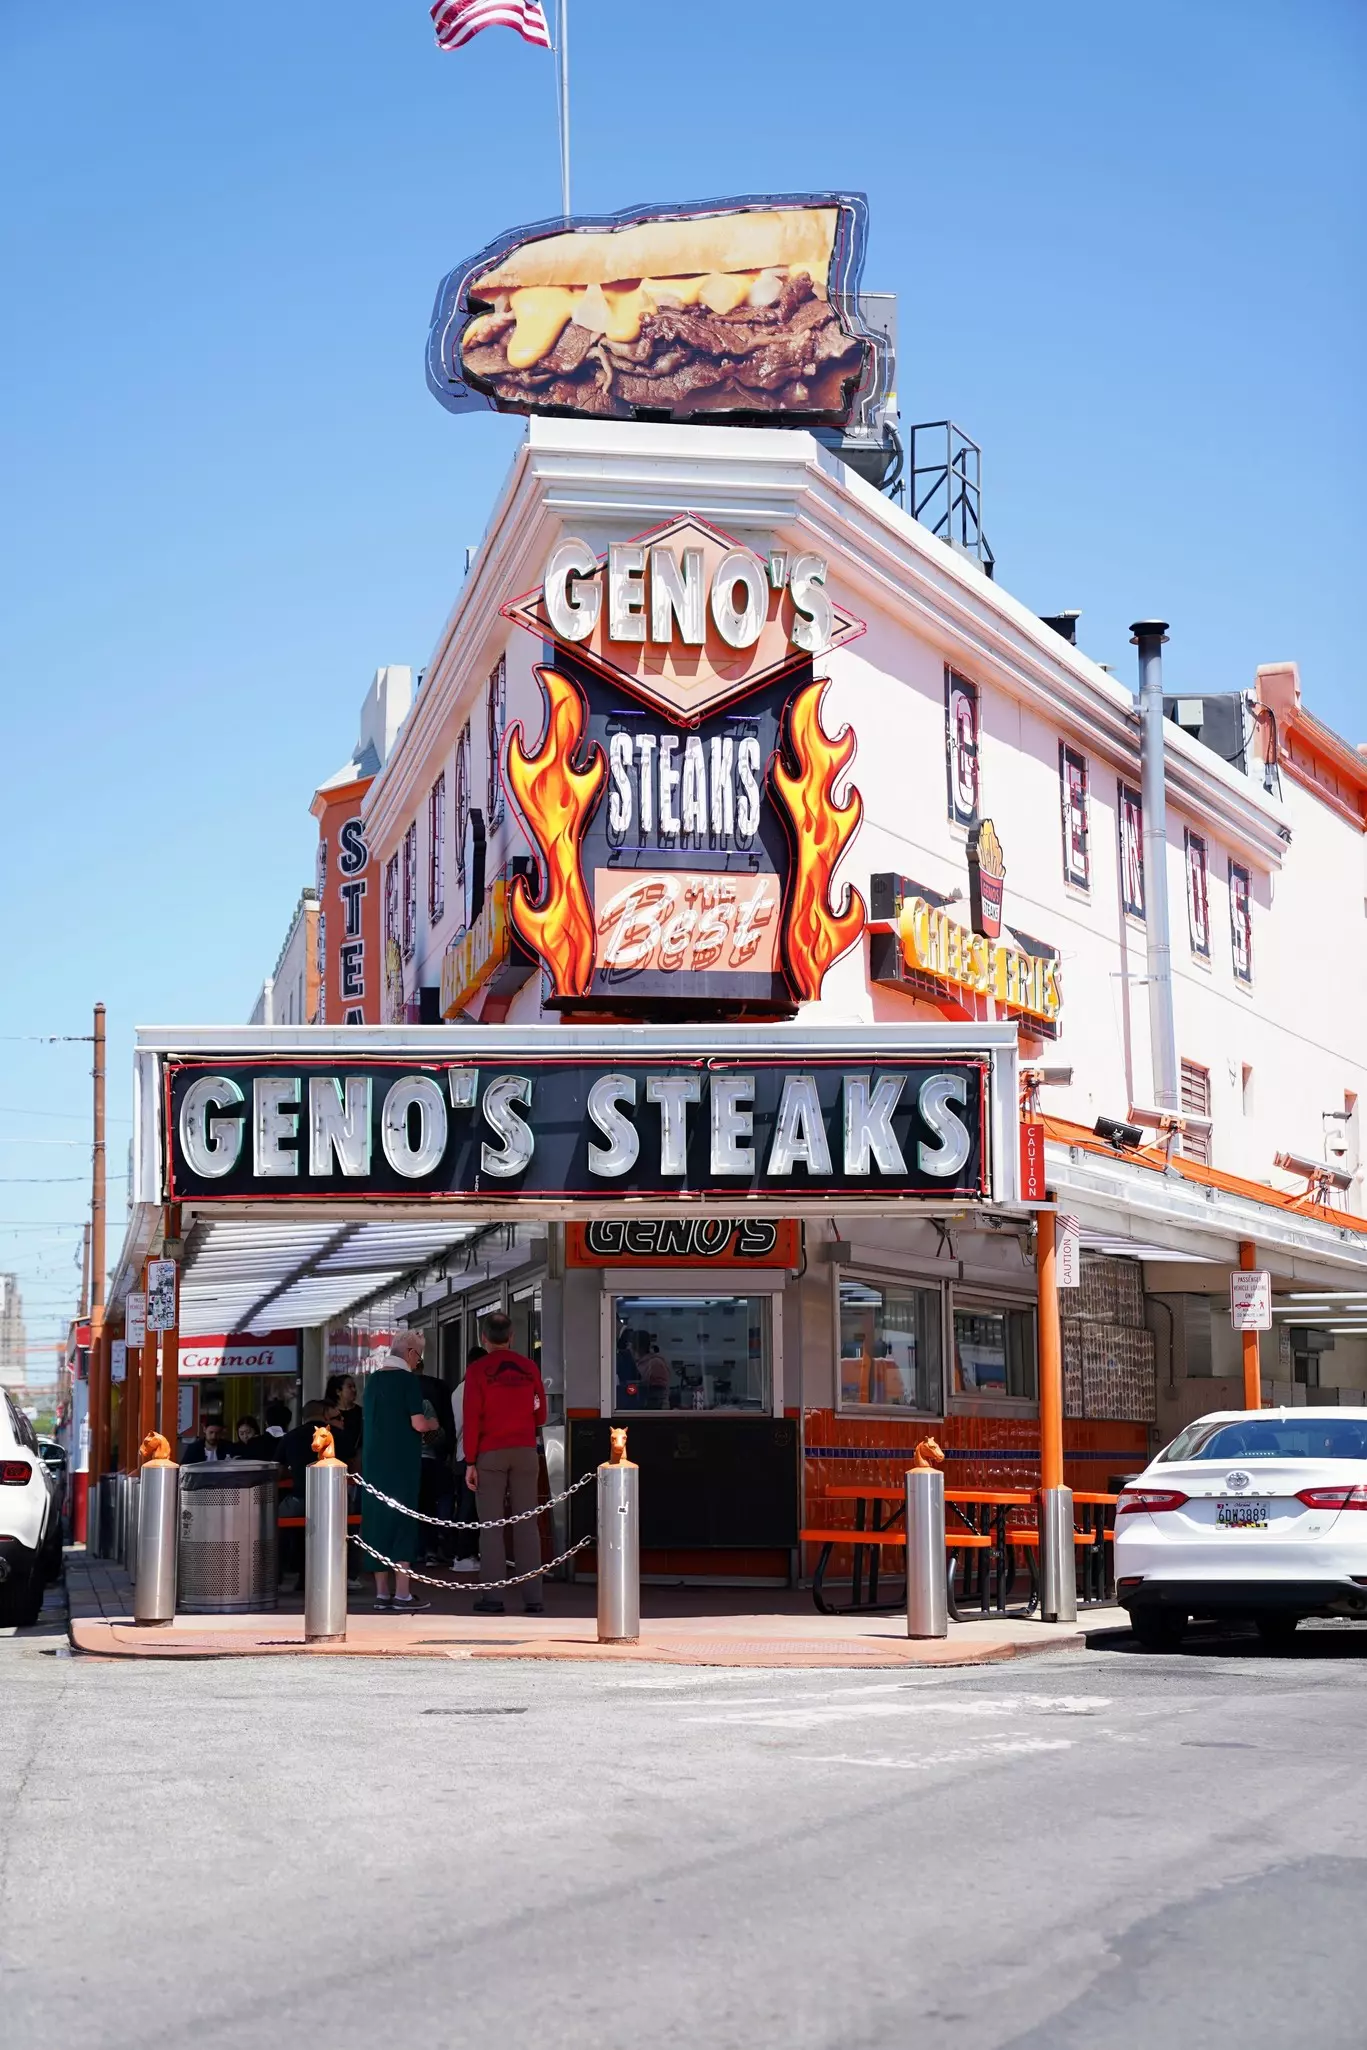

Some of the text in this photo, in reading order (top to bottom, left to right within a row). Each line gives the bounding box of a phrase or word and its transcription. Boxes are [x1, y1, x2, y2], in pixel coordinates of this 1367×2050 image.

[543, 537, 835, 653] GENO'S
[609, 732, 761, 837] STEAKS
[600, 874, 777, 964] Best
[685, 875, 737, 901] THE
[996, 947, 1064, 1022] FRIES
[179, 1068, 970, 1178] GENO'S STEAKS
[1027, 1127, 1037, 1197] CAUTION
[585, 1219, 778, 1256] GENO'S
[1063, 1238, 1072, 1285] CAUTION
[182, 1350, 274, 1368] Cannoli
[1218, 1508, 1267, 1522] 6DW3889
